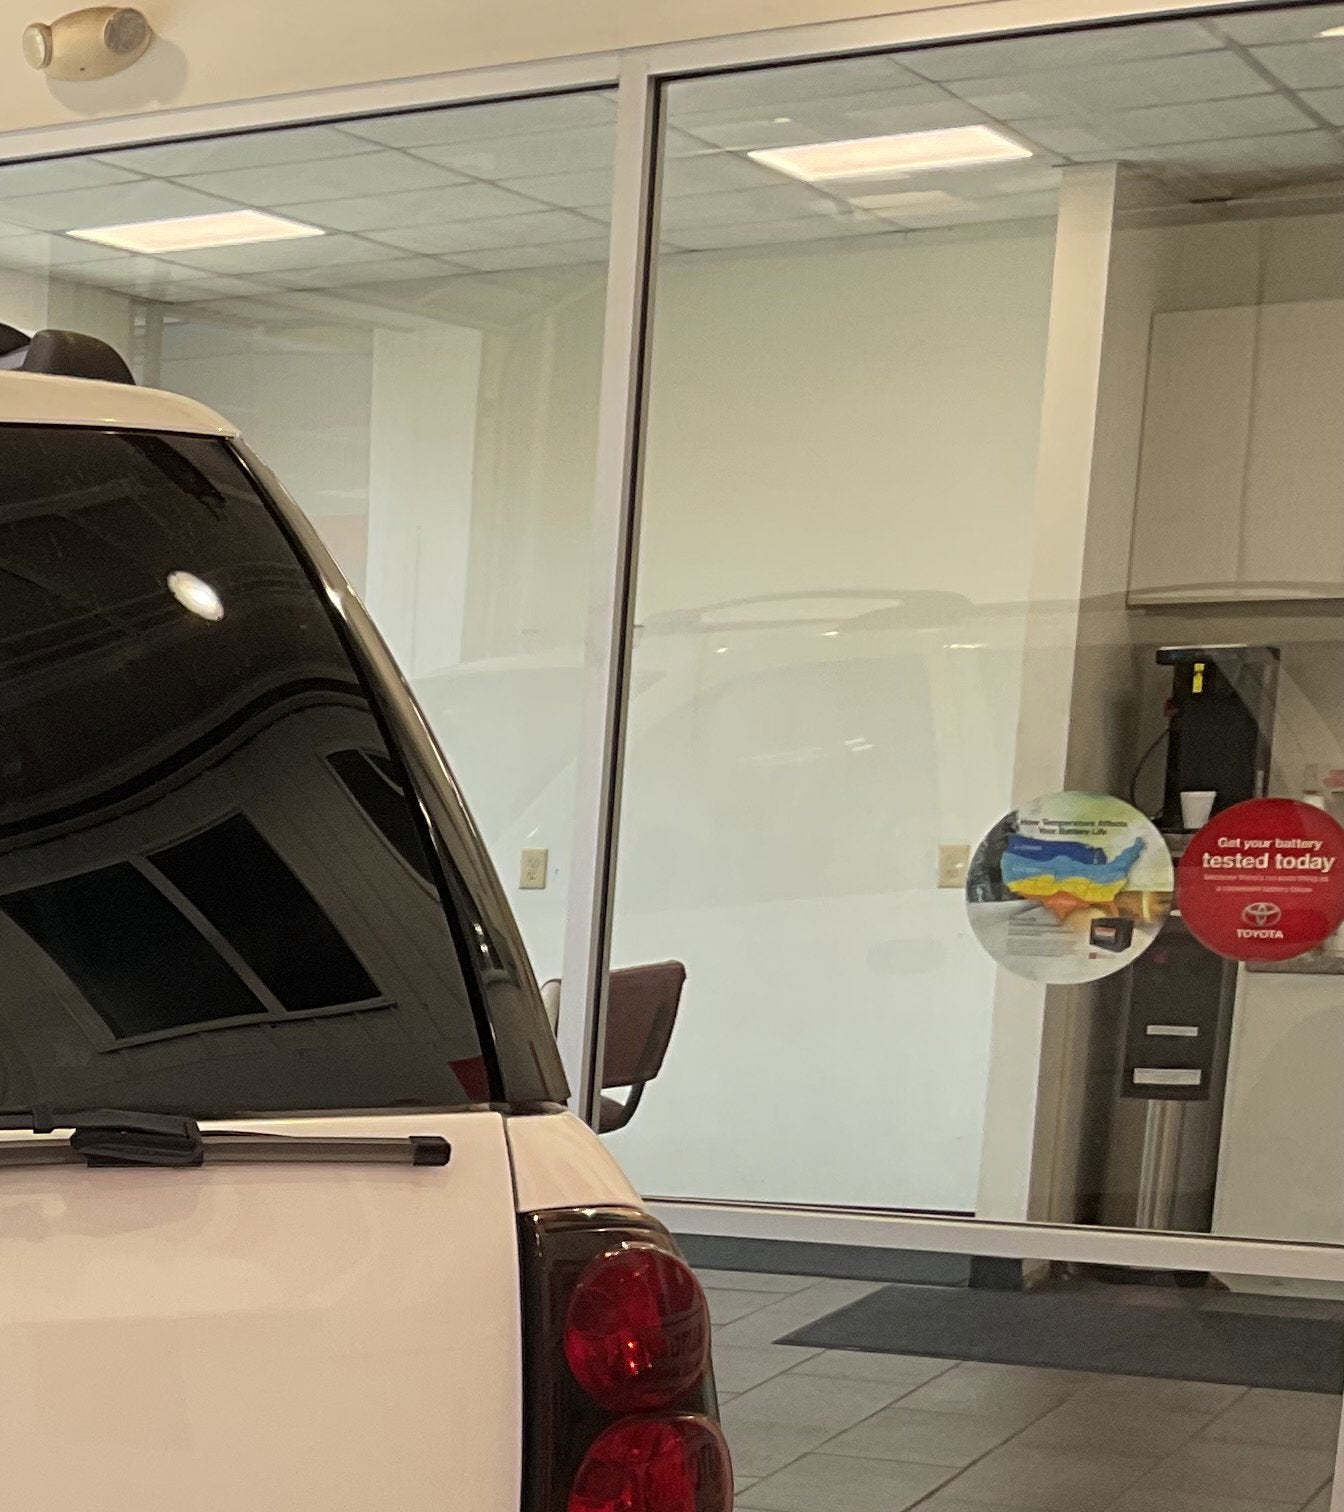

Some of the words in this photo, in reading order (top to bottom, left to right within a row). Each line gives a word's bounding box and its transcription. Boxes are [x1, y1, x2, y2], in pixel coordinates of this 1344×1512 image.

[1217, 837, 1241, 848] Get
[1244, 840, 1273, 850] your
[1275, 838, 1324, 851] battery
[1202, 852, 1269, 869] tested
[1275, 853, 1336, 873] today
[1236, 929, 1284, 939] TOYOTA
